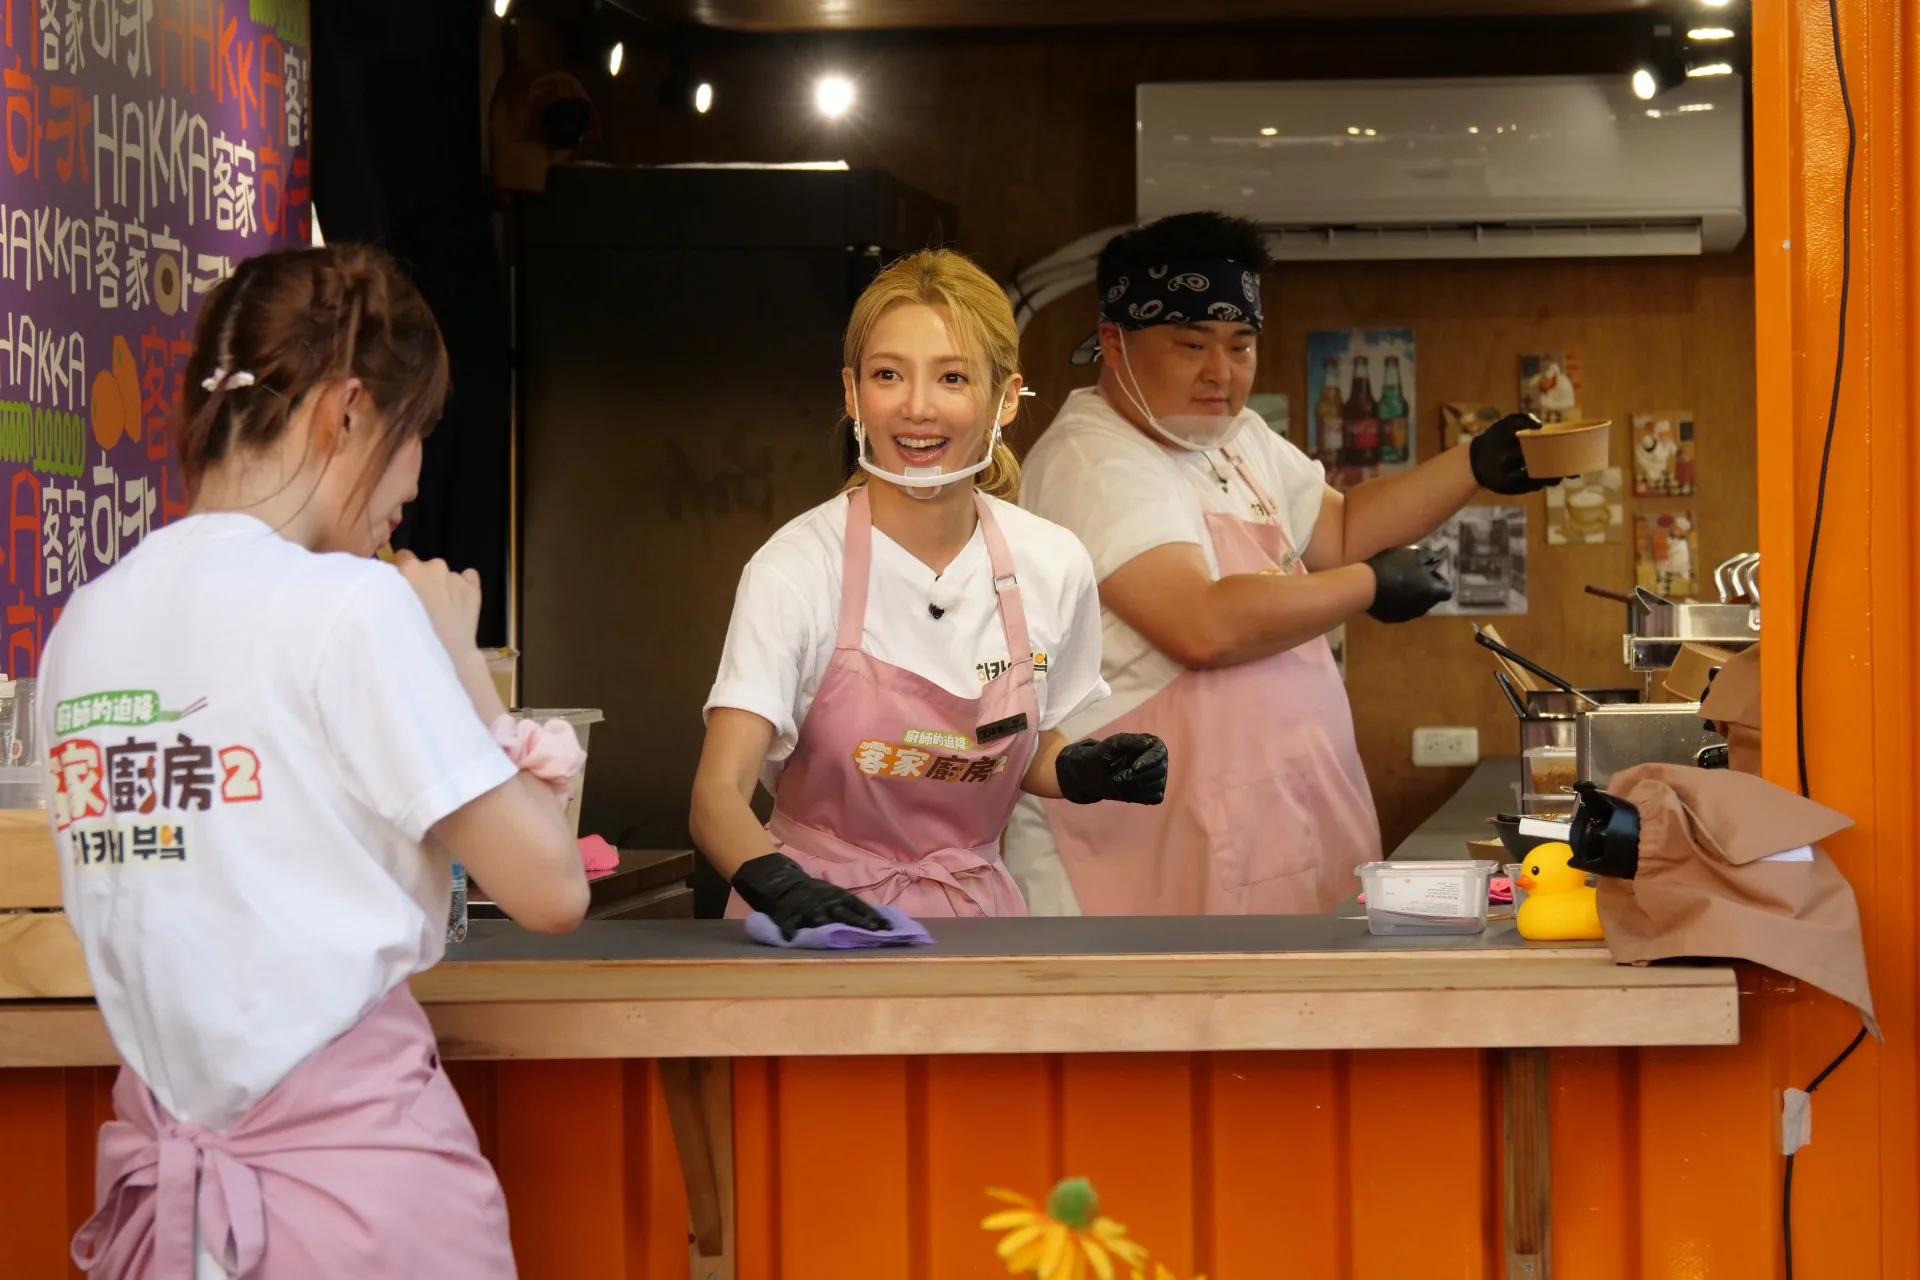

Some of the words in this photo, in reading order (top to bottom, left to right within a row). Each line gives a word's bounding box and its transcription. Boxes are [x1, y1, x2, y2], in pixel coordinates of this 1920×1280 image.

[4, 53, 92, 184] 하카
[94, 93, 211, 227] HAKKA
[212, 130, 257, 238] 客家
[284, 48, 308, 147] 客
[95, 209, 151, 311] 客家
[42, 477, 88, 596] 客家
